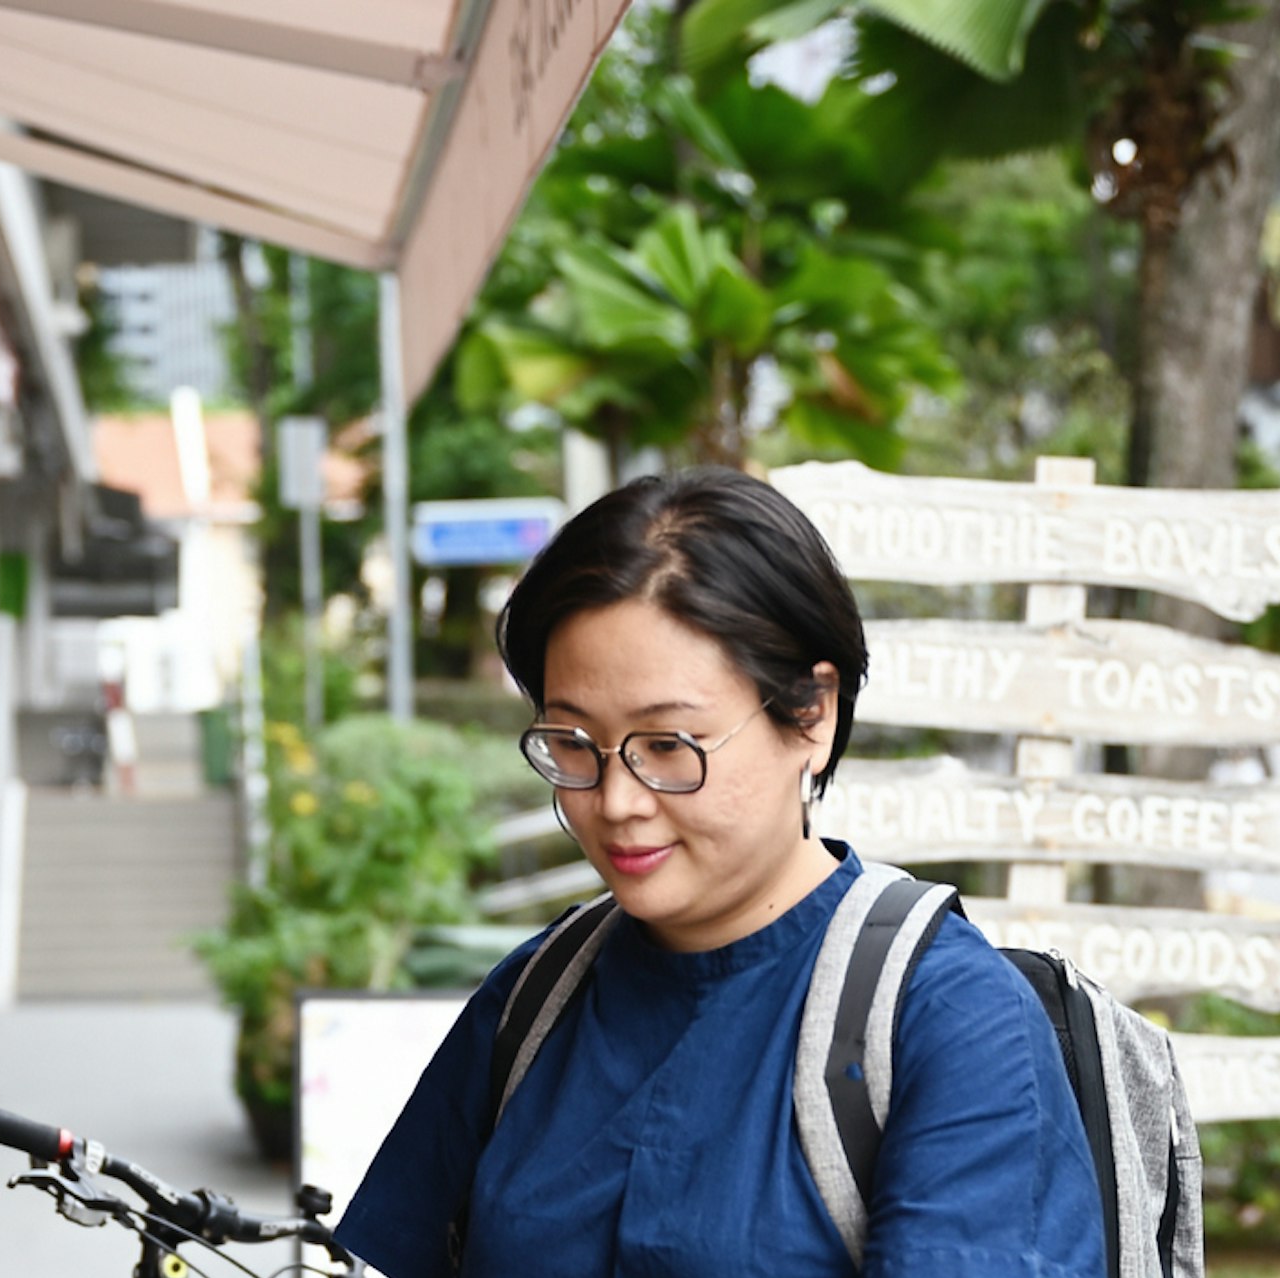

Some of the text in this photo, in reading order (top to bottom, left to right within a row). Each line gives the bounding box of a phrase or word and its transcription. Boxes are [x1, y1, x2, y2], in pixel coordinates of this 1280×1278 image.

[869, 642, 1022, 701] ALTHY
[817, 783, 1262, 853] PECIALTY COFFEE
[1083, 925, 1277, 990] GOODS
